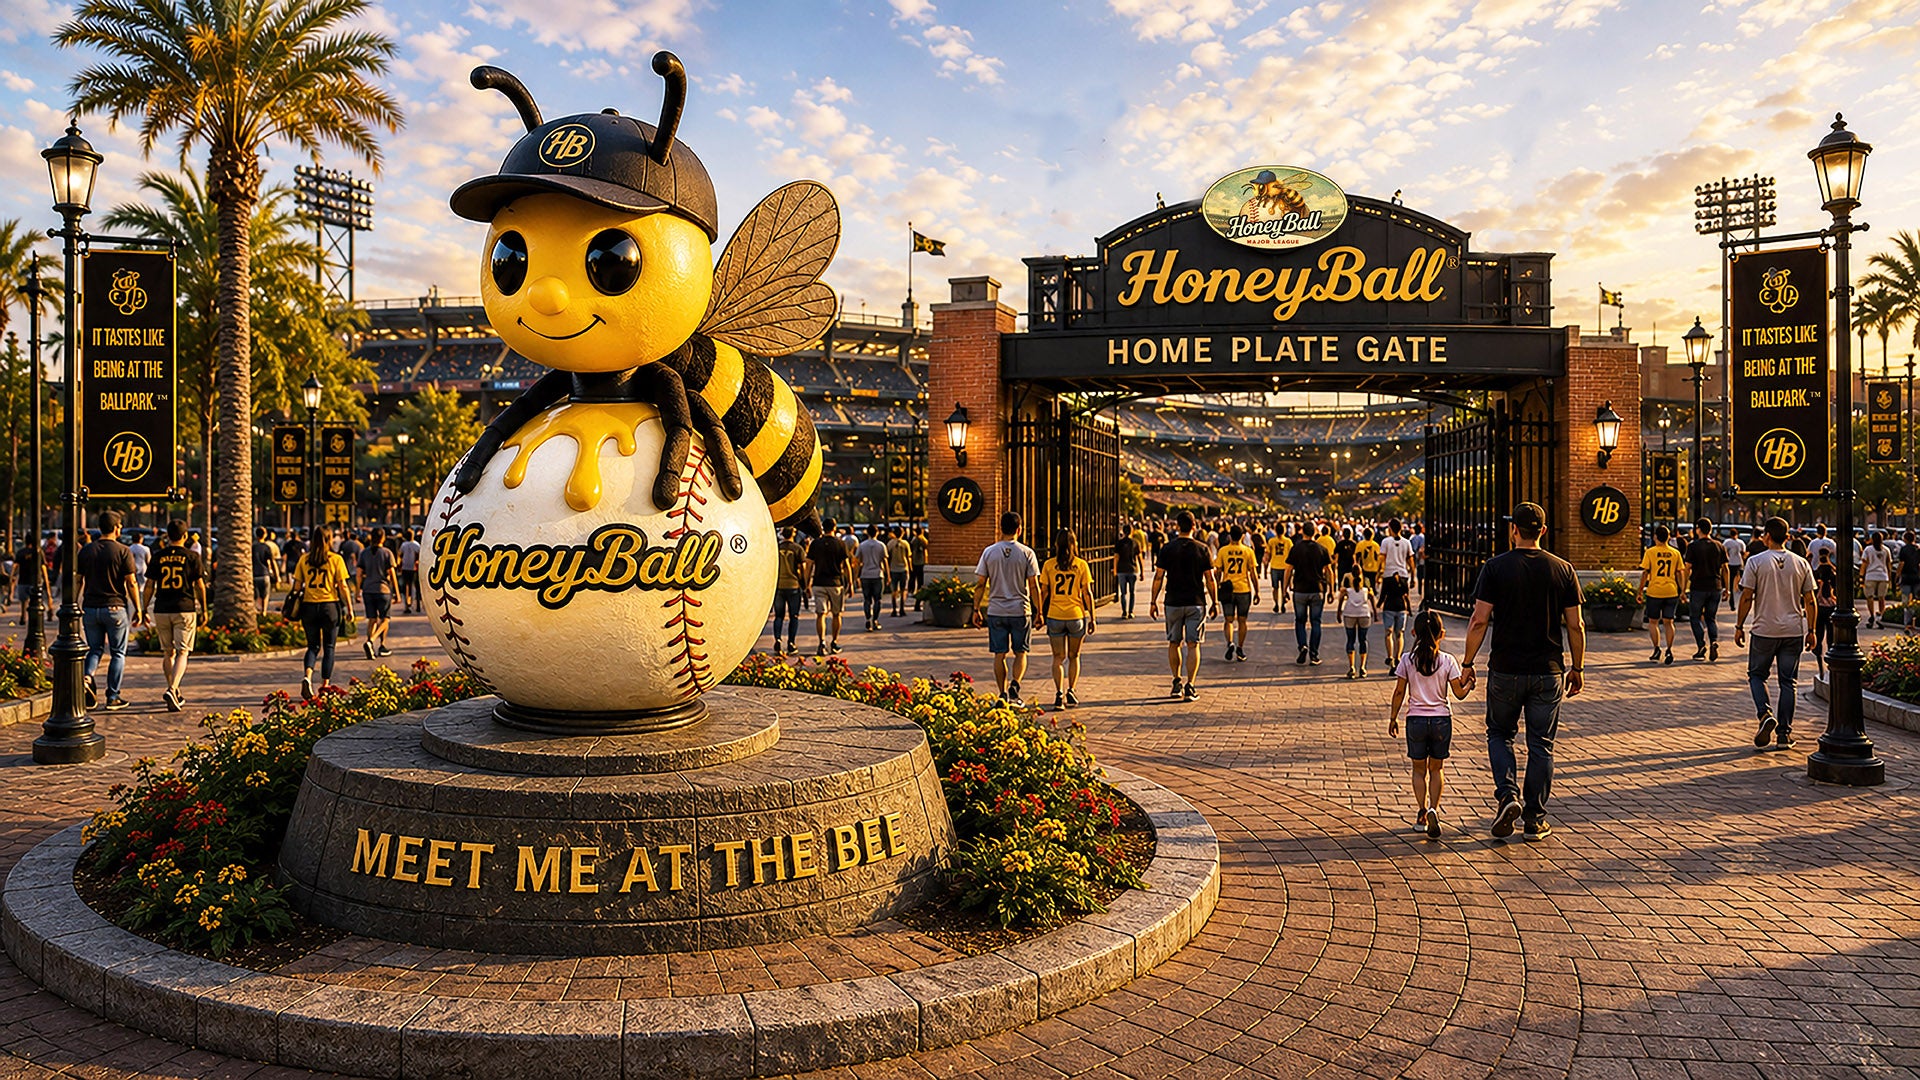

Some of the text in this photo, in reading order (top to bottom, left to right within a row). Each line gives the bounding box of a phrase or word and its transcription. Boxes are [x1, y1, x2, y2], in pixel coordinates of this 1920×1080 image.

[545, 129, 588, 161] HB
[1226, 211, 1322, 238] HoneyBall
[92, 328, 165, 346] IT TASTES LIKE
[1742, 324, 1818, 346] IT TASTES LIKE
[1107, 336, 1448, 365] HOME PLATE GATE
[93, 360, 163, 378] BEING AT THE
[1744, 356, 1817, 377] BEING AT THE
[112, 440, 145, 473] HB
[1763, 437, 1798, 470] HB
[947, 487, 973, 514] HB
[1592, 496, 1620, 524] HB
[161, 566, 183, 589] 25
[1656, 559, 1672, 577] 21
[1055, 573, 1076, 596] 27
[350, 811, 907, 894] MEET ME AT THE BEE
